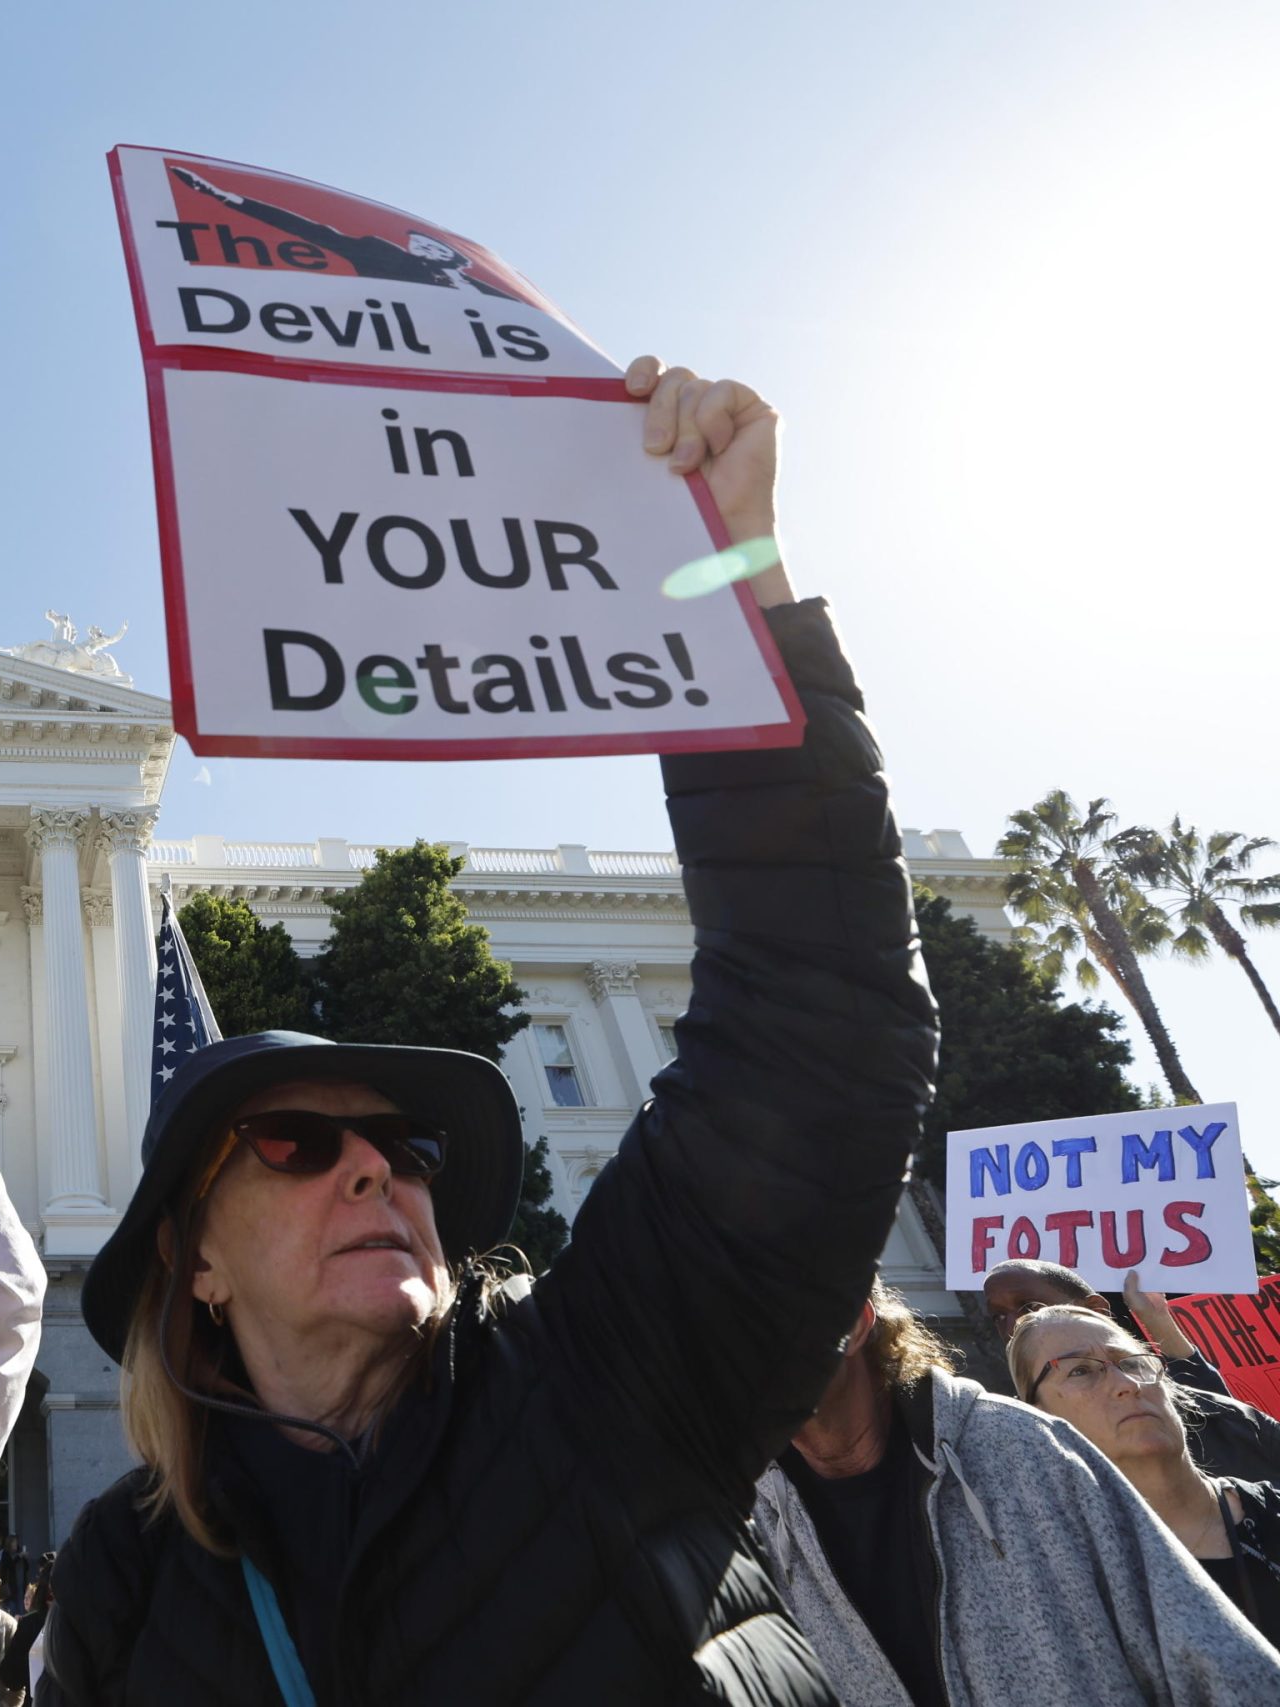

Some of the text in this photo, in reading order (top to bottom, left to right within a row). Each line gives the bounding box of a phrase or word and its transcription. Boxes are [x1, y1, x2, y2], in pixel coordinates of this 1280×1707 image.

[156, 219, 329, 270] The
[177, 286, 550, 362] Devil is
[380, 407, 476, 478] in
[287, 507, 620, 592] YOUR
[261, 627, 710, 715] Details!
[969, 1121, 1228, 1198] NOT MY
[971, 1200, 1213, 1274] FOTUS
[1191, 1294, 1279, 1368] THE
